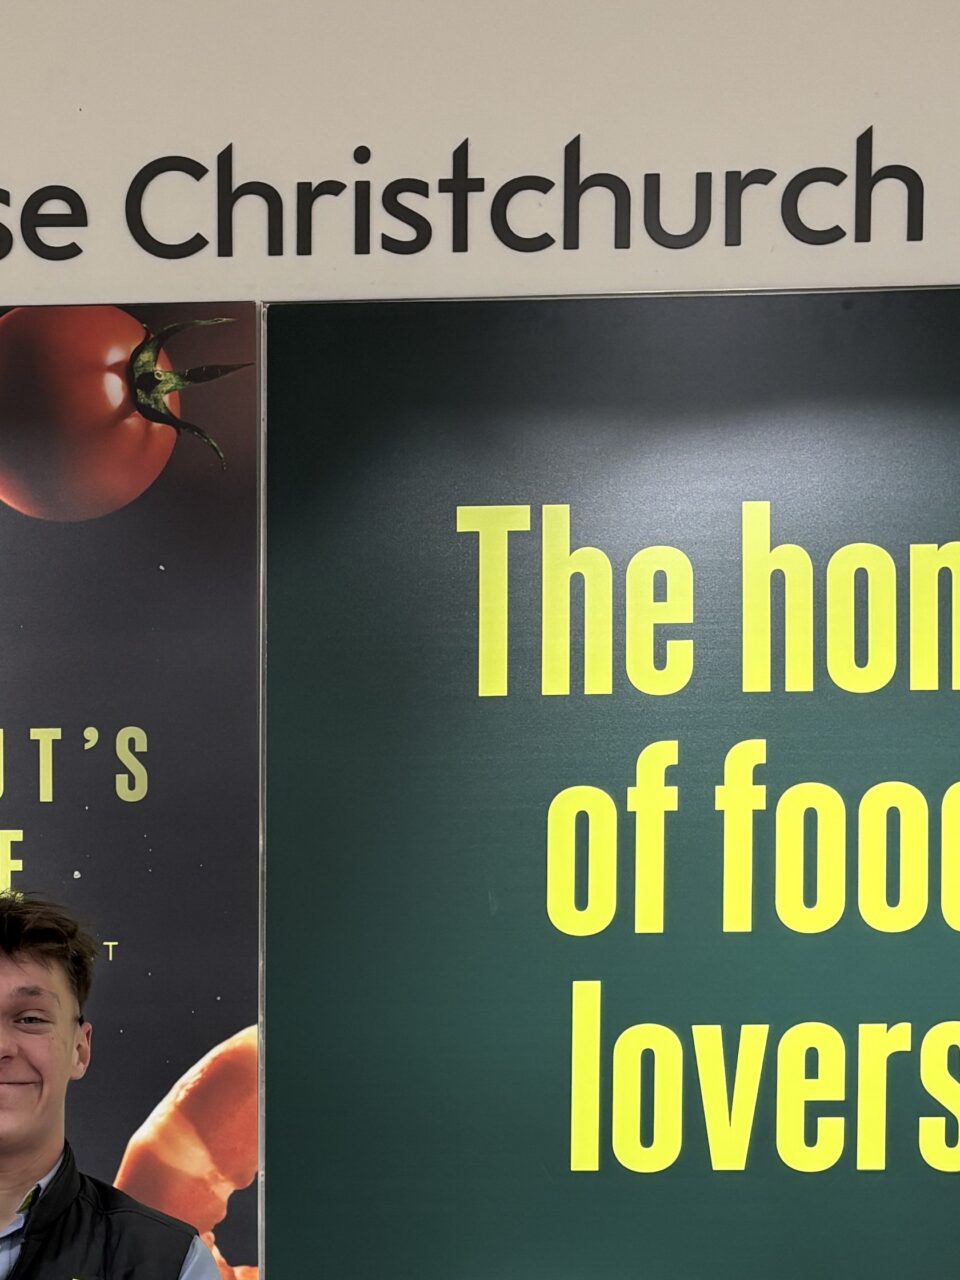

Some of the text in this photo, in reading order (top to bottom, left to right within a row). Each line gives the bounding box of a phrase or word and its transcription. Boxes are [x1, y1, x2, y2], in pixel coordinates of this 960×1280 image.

[125, 125, 925, 260] Christchurch
[456, 504, 693, 697] The
[547, 738, 960, 936] of foo
[571, 979, 960, 1173] lovers
